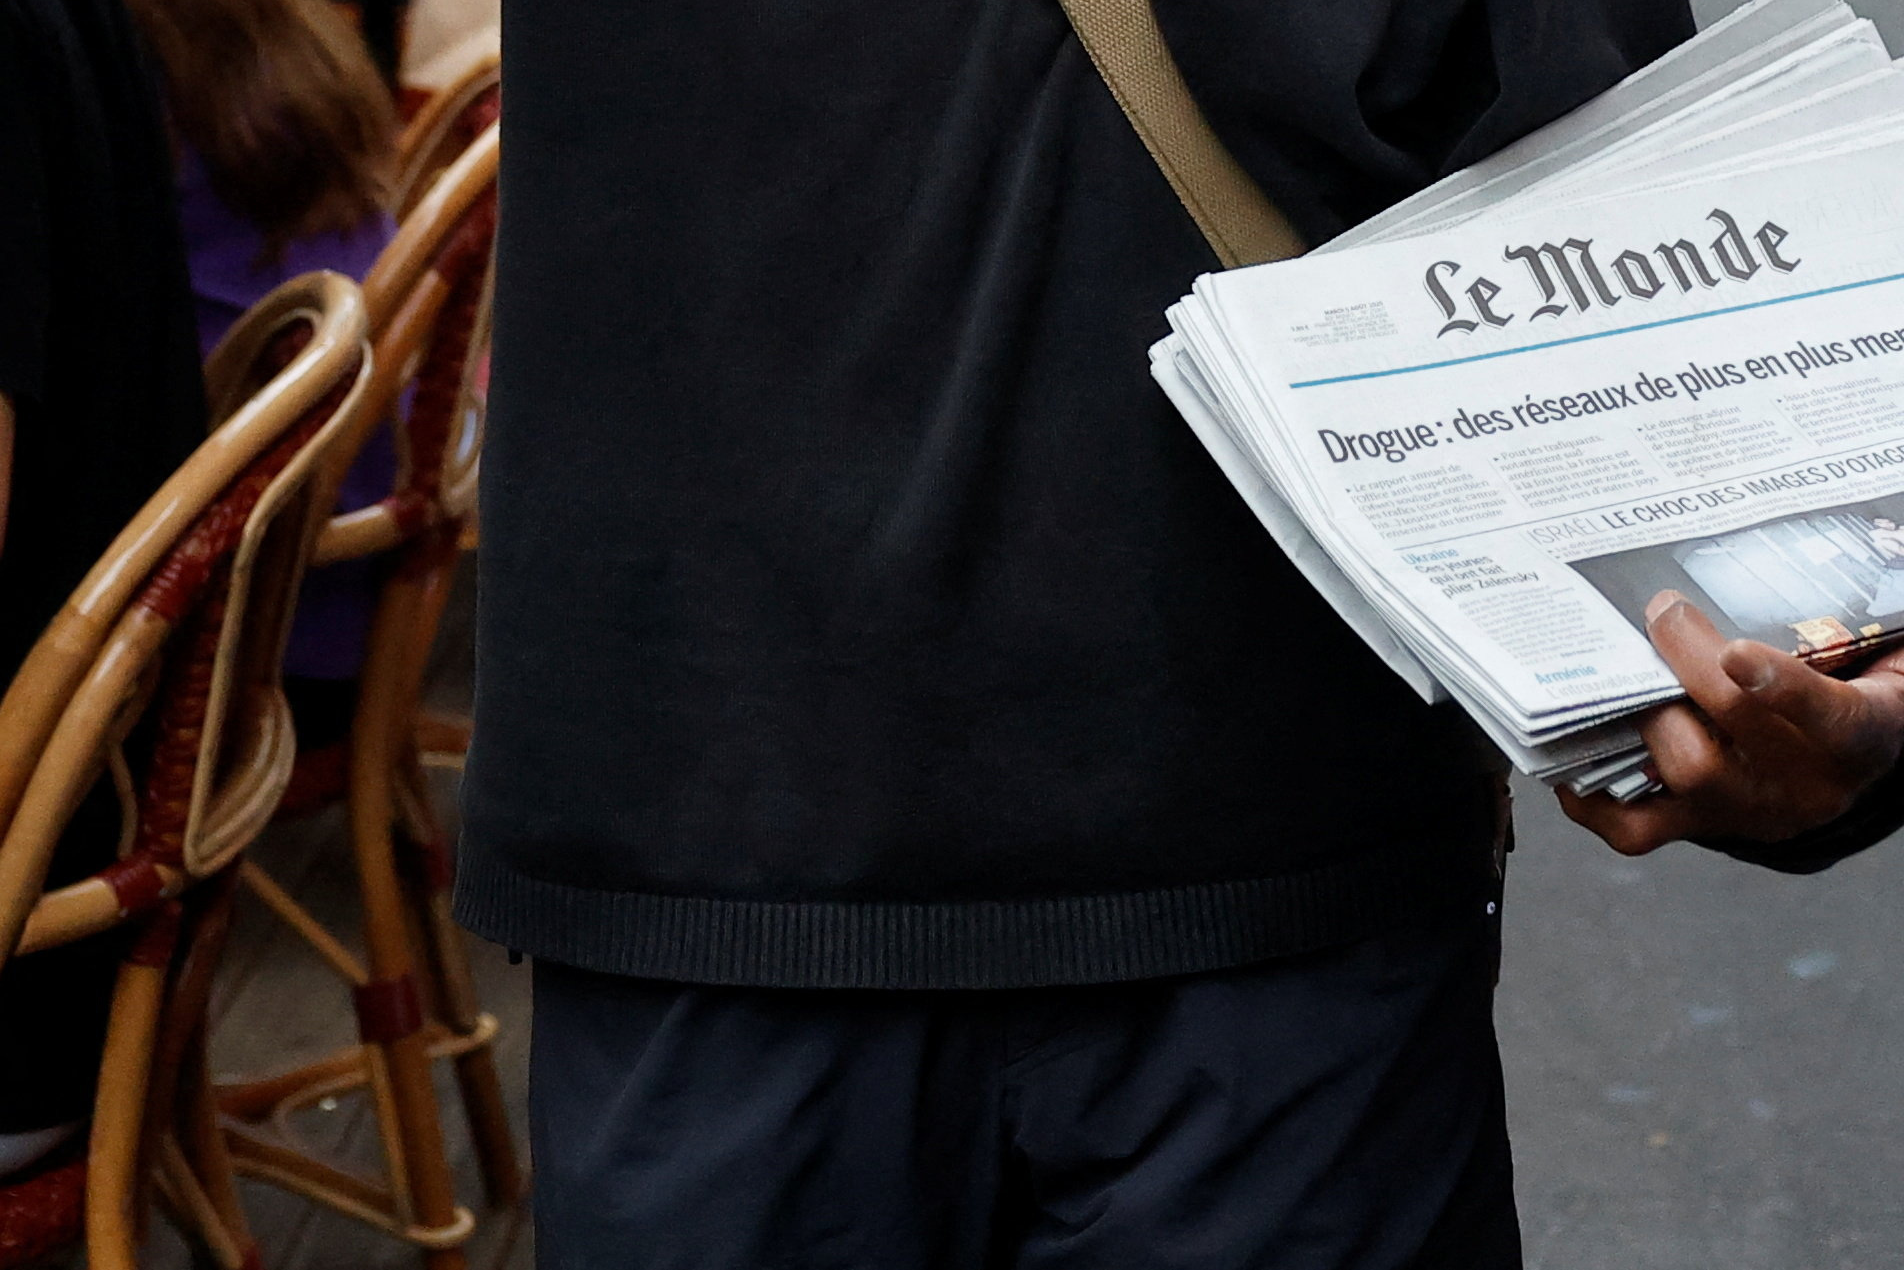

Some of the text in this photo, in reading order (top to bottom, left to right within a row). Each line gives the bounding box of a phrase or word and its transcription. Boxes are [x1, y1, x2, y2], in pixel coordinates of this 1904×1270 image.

[1422, 260, 1515, 339] Le
[1501, 207, 1802, 322] Monde
[1809, 387, 1824, 396] du
[1860, 396, 1876, 405] sur
[1317, 422, 1439, 464] Drogue
[1453, 407, 1515, 441] des
[1511, 383, 1638, 429] réseaux
[1635, 372, 1678, 403] de
[1675, 361, 1747, 402] plus
[1744, 352, 1788, 381] en
[1785, 340, 1854, 379] plus
[1789, 401, 1807, 410] des
[1855, 400, 1897, 416] national
[1650, 418, 1774, 450] de constate la
[1807, 428, 1820, 437] ne
[1858, 416, 1872, 425] de
[1876, 422, 1889, 430] en
[1643, 433, 1656, 441] de
[1718, 437, 1737, 446] des
[1737, 428, 1777, 442] services
[1501, 450, 1526, 460] Pour
[1526, 446, 1542, 455] les
[1566, 460, 1577, 468] la
[1614, 449, 1631, 458] est
[1664, 459, 1678, 468] de
[1712, 449, 1722, 458] et
[1722, 446, 1737, 455] de
[1772, 435, 1793, 444] face
[1500, 452, 1561, 471] notamment
[1367, 474, 1408, 490] rapport
[1408, 465, 1445, 481] annuel
[1446, 463, 1461, 472] de
[1521, 480, 1532, 489] la
[1533, 477, 1553, 486] fois
[1554, 473, 1569, 482] un
[1618, 457, 1639, 468] fort
[1569, 480, 1580, 489] et
[1582, 476, 1603, 486] une
[1604, 471, 1629, 482] zone
[1629, 467, 1644, 476] de
[1634, 475, 1658, 488] pays
[1442, 479, 1488, 494] combien
[1451, 497, 1506, 514] désormais
[1527, 515, 1607, 547] ISRAËL
[1601, 509, 1636, 530] LE
[1632, 497, 1699, 522] CHOC
[1698, 487, 1746, 508] DES
[1741, 467, 1829, 496] IMAGES
[1401, 547, 1460, 566] Ukraine
[1414, 555, 1494, 574] Ces jeunes
[1430, 564, 1506, 587] qui ont fait
[1442, 581, 1474, 599] plier
[1535, 663, 1599, 686] Arménie
